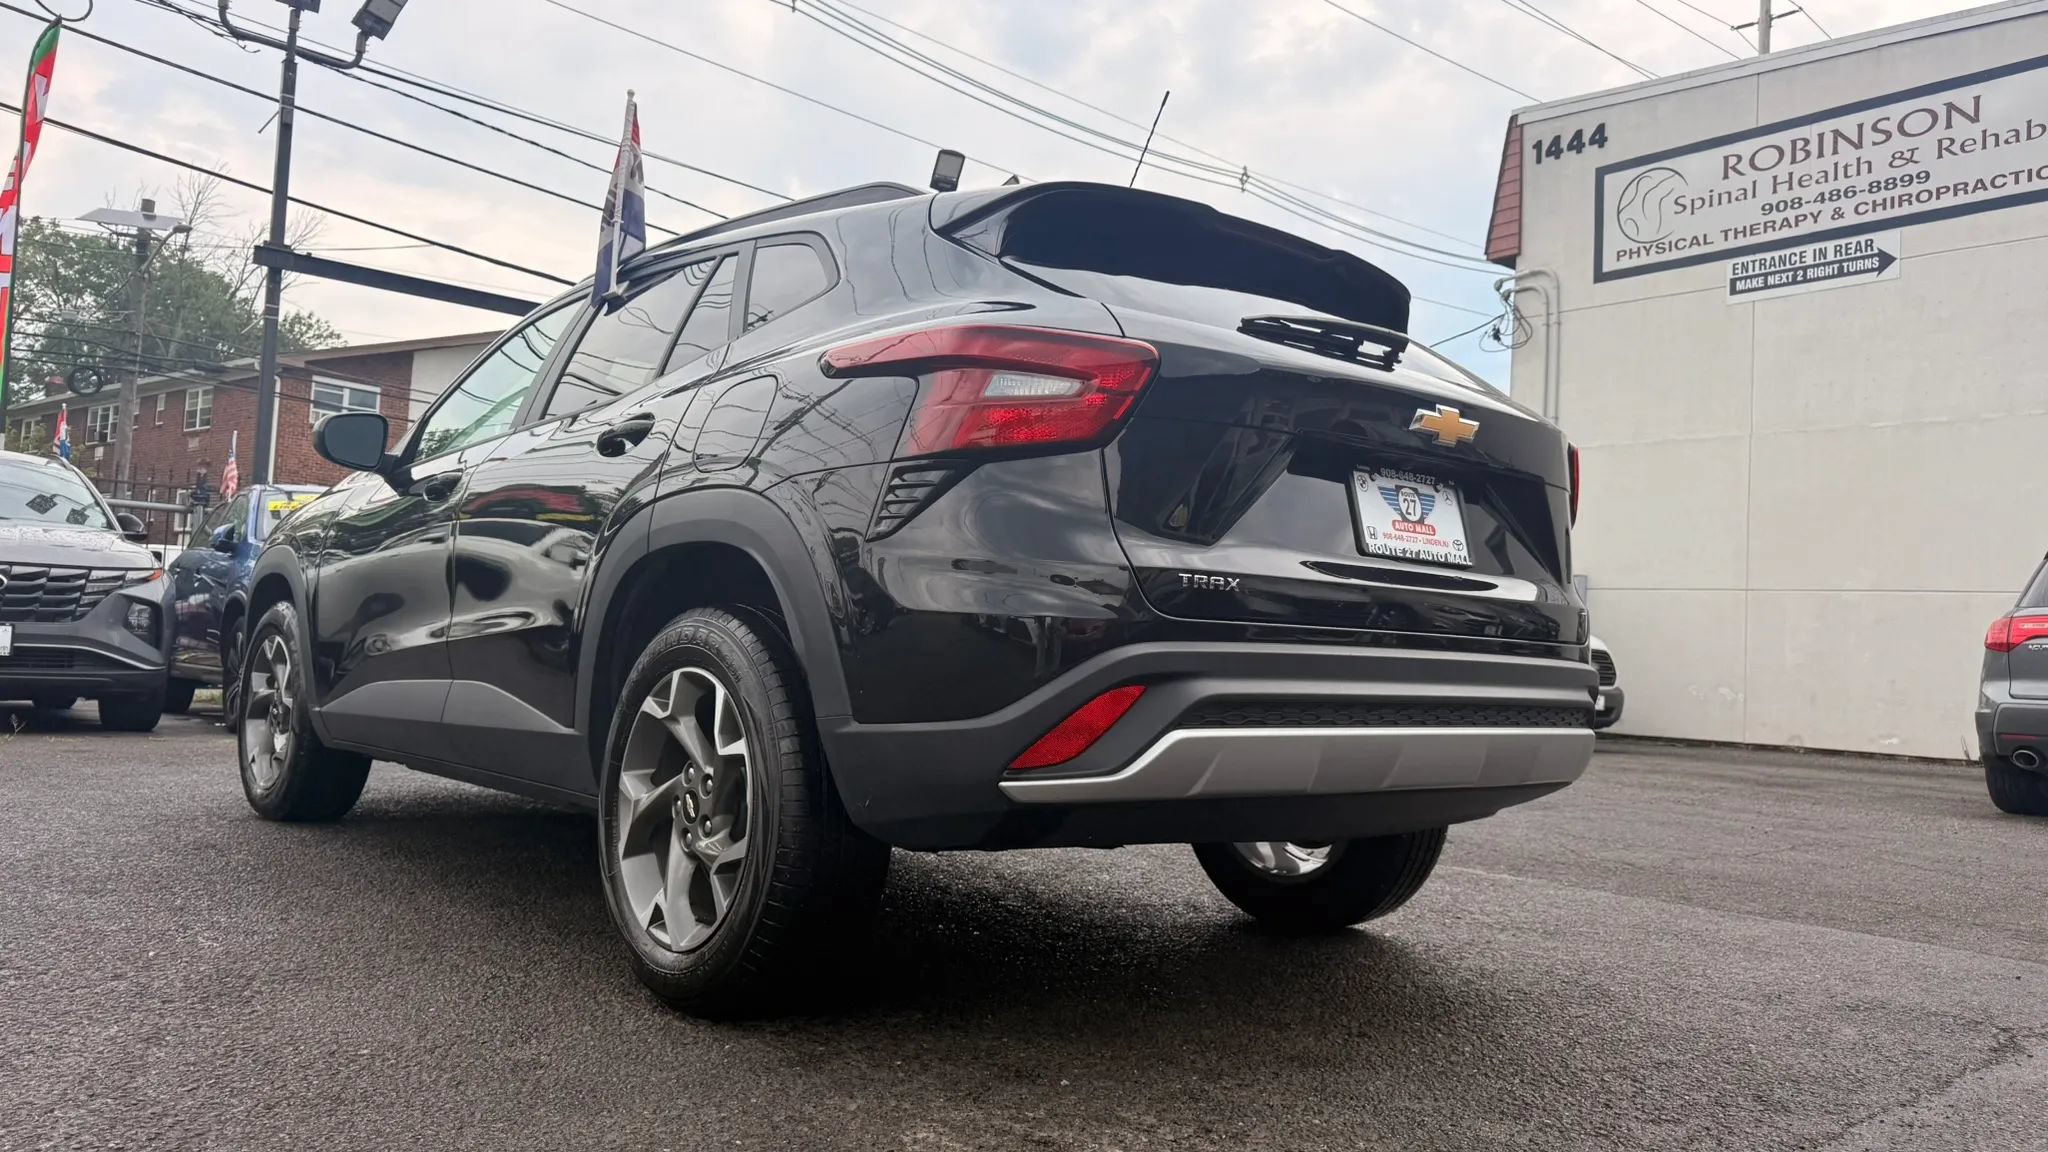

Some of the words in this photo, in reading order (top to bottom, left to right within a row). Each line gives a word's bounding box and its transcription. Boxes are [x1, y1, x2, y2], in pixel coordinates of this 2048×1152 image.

[1532, 122, 1608, 164] 1444
[1722, 95, 1982, 180] ROBINSON
[1673, 179, 1757, 215] Spinal
[1772, 156, 1873, 195] Health
[1888, 147, 1920, 168] &
[1936, 118, 2048, 160] Rehab
[1760, 170, 1930, 216] 908-486-8899
[1616, 233, 1714, 262] PHYSICAL
[1720, 210, 1822, 242] THERAPY
[1830, 207, 1845, 221] &
[1732, 250, 1807, 276] ENTRANCE
[1813, 246, 1828, 262] IN
[1834, 238, 1874, 258] REAR
[1736, 276, 1765, 292] MAKE
[1767, 271, 1794, 286] NEXT
[1796, 270, 1804, 281] 2
[1807, 263, 1839, 279] RIGHT
[1843, 256, 1880, 274] TURNS
[1380, 467, 1436, 485] 908-648-2727
[1403, 497, 1417, 517] 27
[1395, 521, 1413, 531] AUTO
[1415, 524, 1434, 535] MALL
[1368, 544, 1403, 556] ROUTE
[1405, 548, 1416, 558] 27
[1419, 549, 1444, 561] AUTO
[1447, 554, 1473, 565] MALL
[1178, 573, 1240, 591] TRAX
